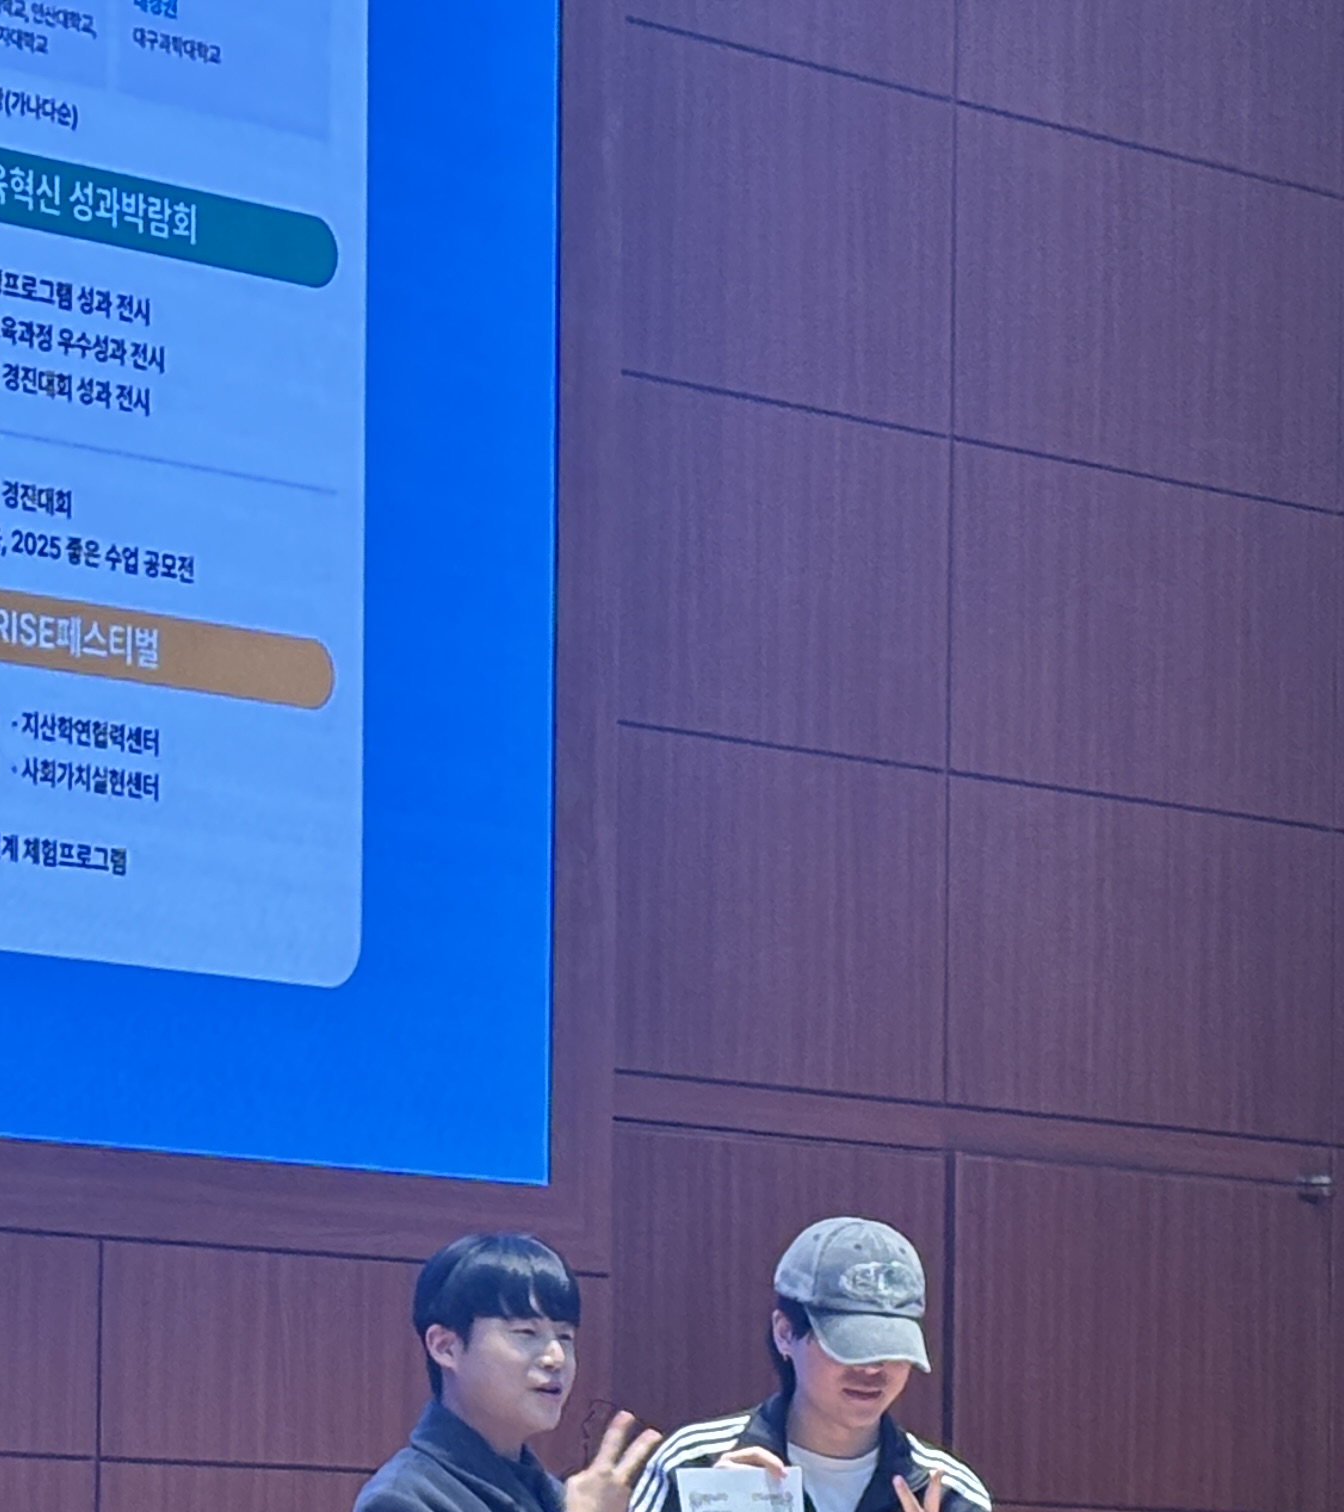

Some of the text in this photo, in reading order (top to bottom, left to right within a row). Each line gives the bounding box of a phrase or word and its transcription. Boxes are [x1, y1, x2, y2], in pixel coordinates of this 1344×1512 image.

[69, 181, 197, 244] 성과박람회
[78, 286, 112, 319] 성과
[116, 295, 151, 327] 전시
[58, 329, 127, 366] 우수성과
[131, 343, 166, 375] 전시
[3, 363, 72, 402] 경진대회
[76, 376, 111, 410] 성과
[116, 384, 151, 417] 전시
[2, 479, 73, 519] 경진대회
[11, 530, 61, 560] 2025
[65, 537, 101, 569] 좋은
[104, 544, 139, 575] 수업
[143, 551, 195, 584] 공모전
[21, 711, 159, 757] 지산학연협력센터
[23, 837, 127, 877] 체험프로그램
